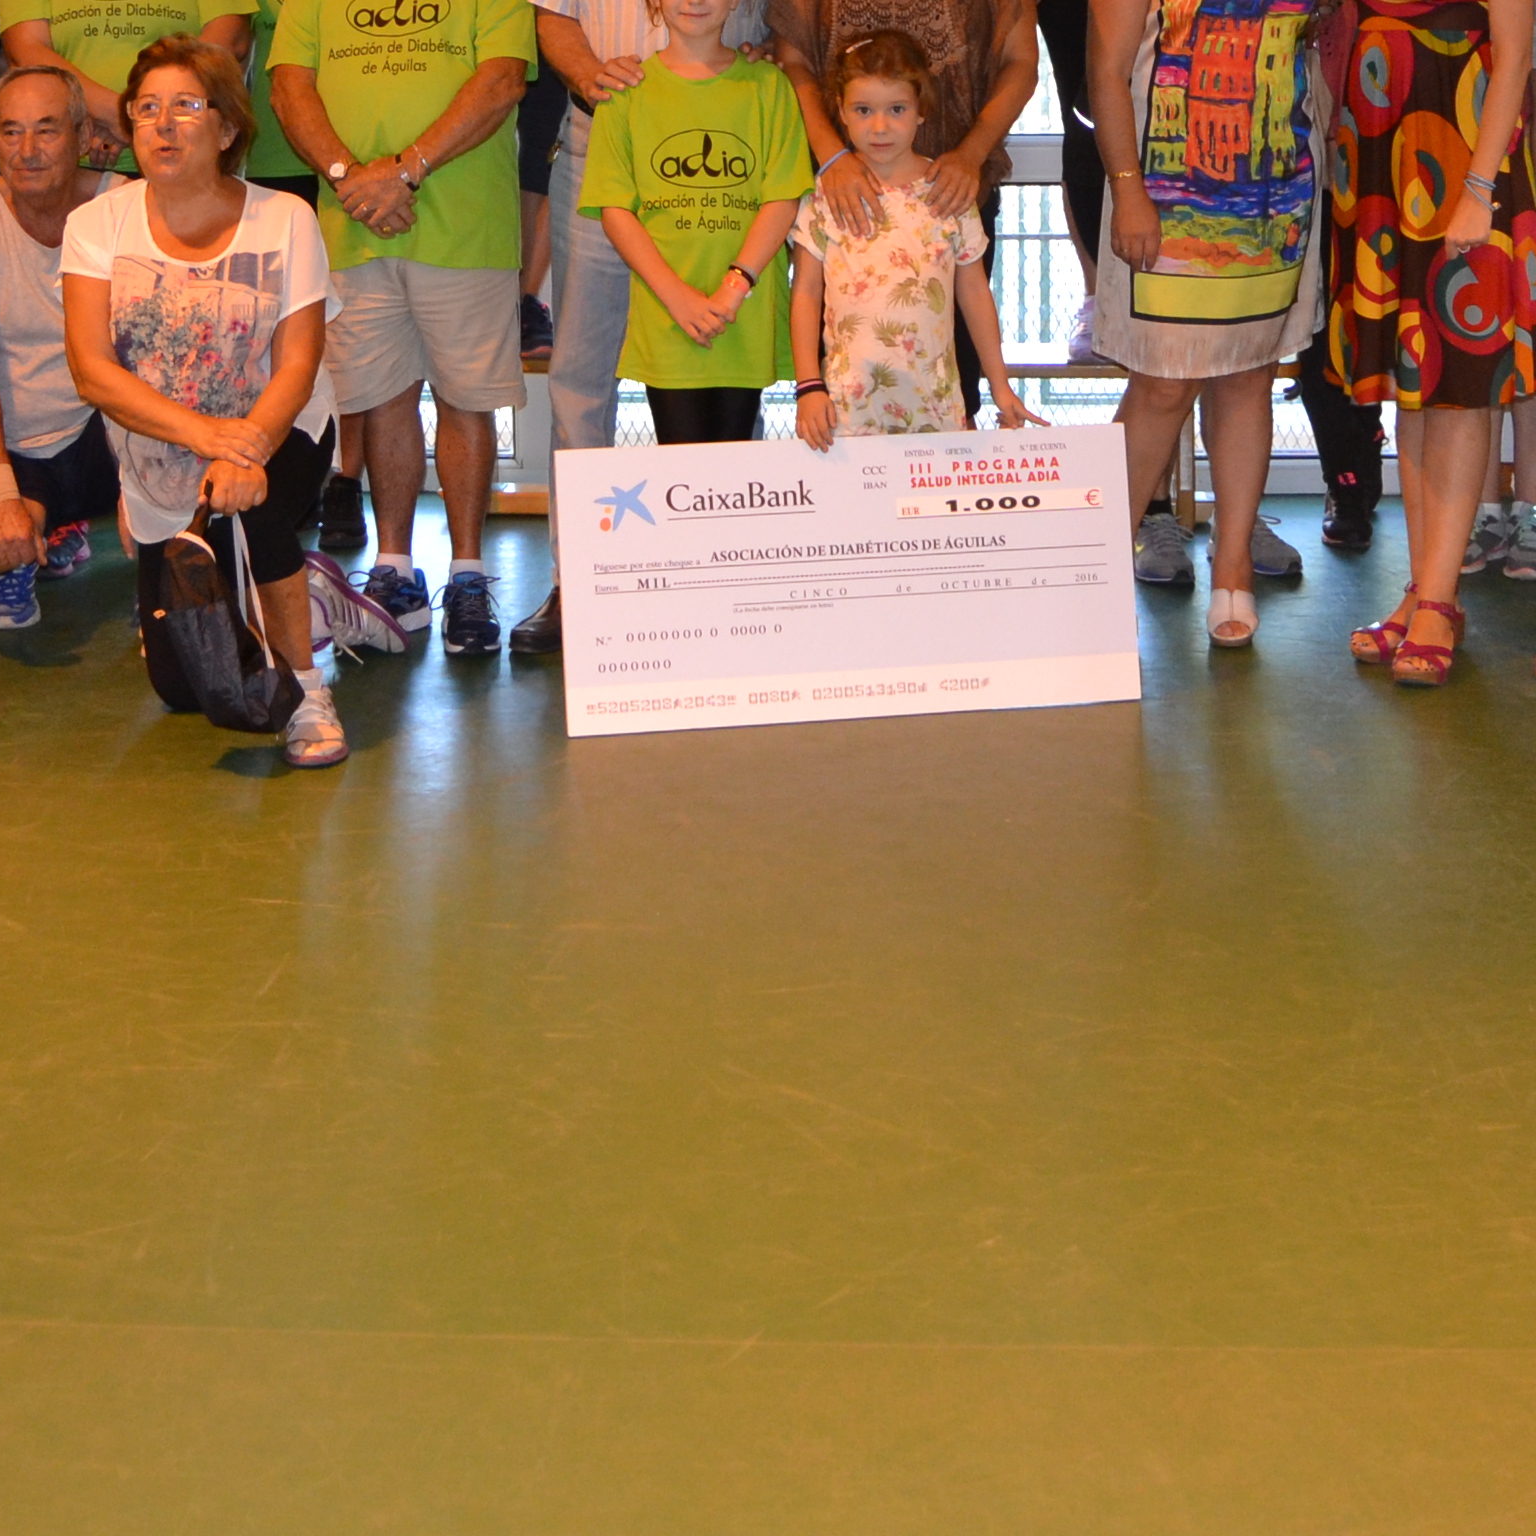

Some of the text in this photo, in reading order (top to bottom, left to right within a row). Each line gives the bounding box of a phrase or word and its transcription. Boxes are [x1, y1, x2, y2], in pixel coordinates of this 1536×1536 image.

[105, 3, 122, 17] de
[126, 3, 187, 21] Diabéticos
[83, 19, 146, 39] de Águilas
[328, 38, 467, 61] Asociación de Diabéticos
[362, 56, 427, 75] de Águilas
[660, 132, 749, 180] adia
[642, 193, 695, 211] sociación
[700, 192, 717, 207] de
[675, 210, 741, 233] de Águilas
[1040, 443, 1067, 451] CUENTA
[862, 456, 1060, 475] CCC III PROGRAMA
[863, 470, 1061, 489] IBAN SALUD INTEGRAL ADIA
[665, 478, 815, 512] CaixaBank
[901, 507, 920, 516] EUR
[945, 495, 1041, 512] 1.000
[629, 563, 644, 571] por
[710, 544, 803, 563] ASOCIACIÓN
[806, 545, 826, 556] DE
[829, 539, 919, 556] DIABÉTICOS
[922, 539, 941, 550] DE
[944, 535, 1007, 549] ÁGUILAS
[594, 577, 671, 593] Euros MIL
[789, 573, 1098, 599] CINCO de OCTUBRE de 2016
[598, 659, 672, 673] 0000000
